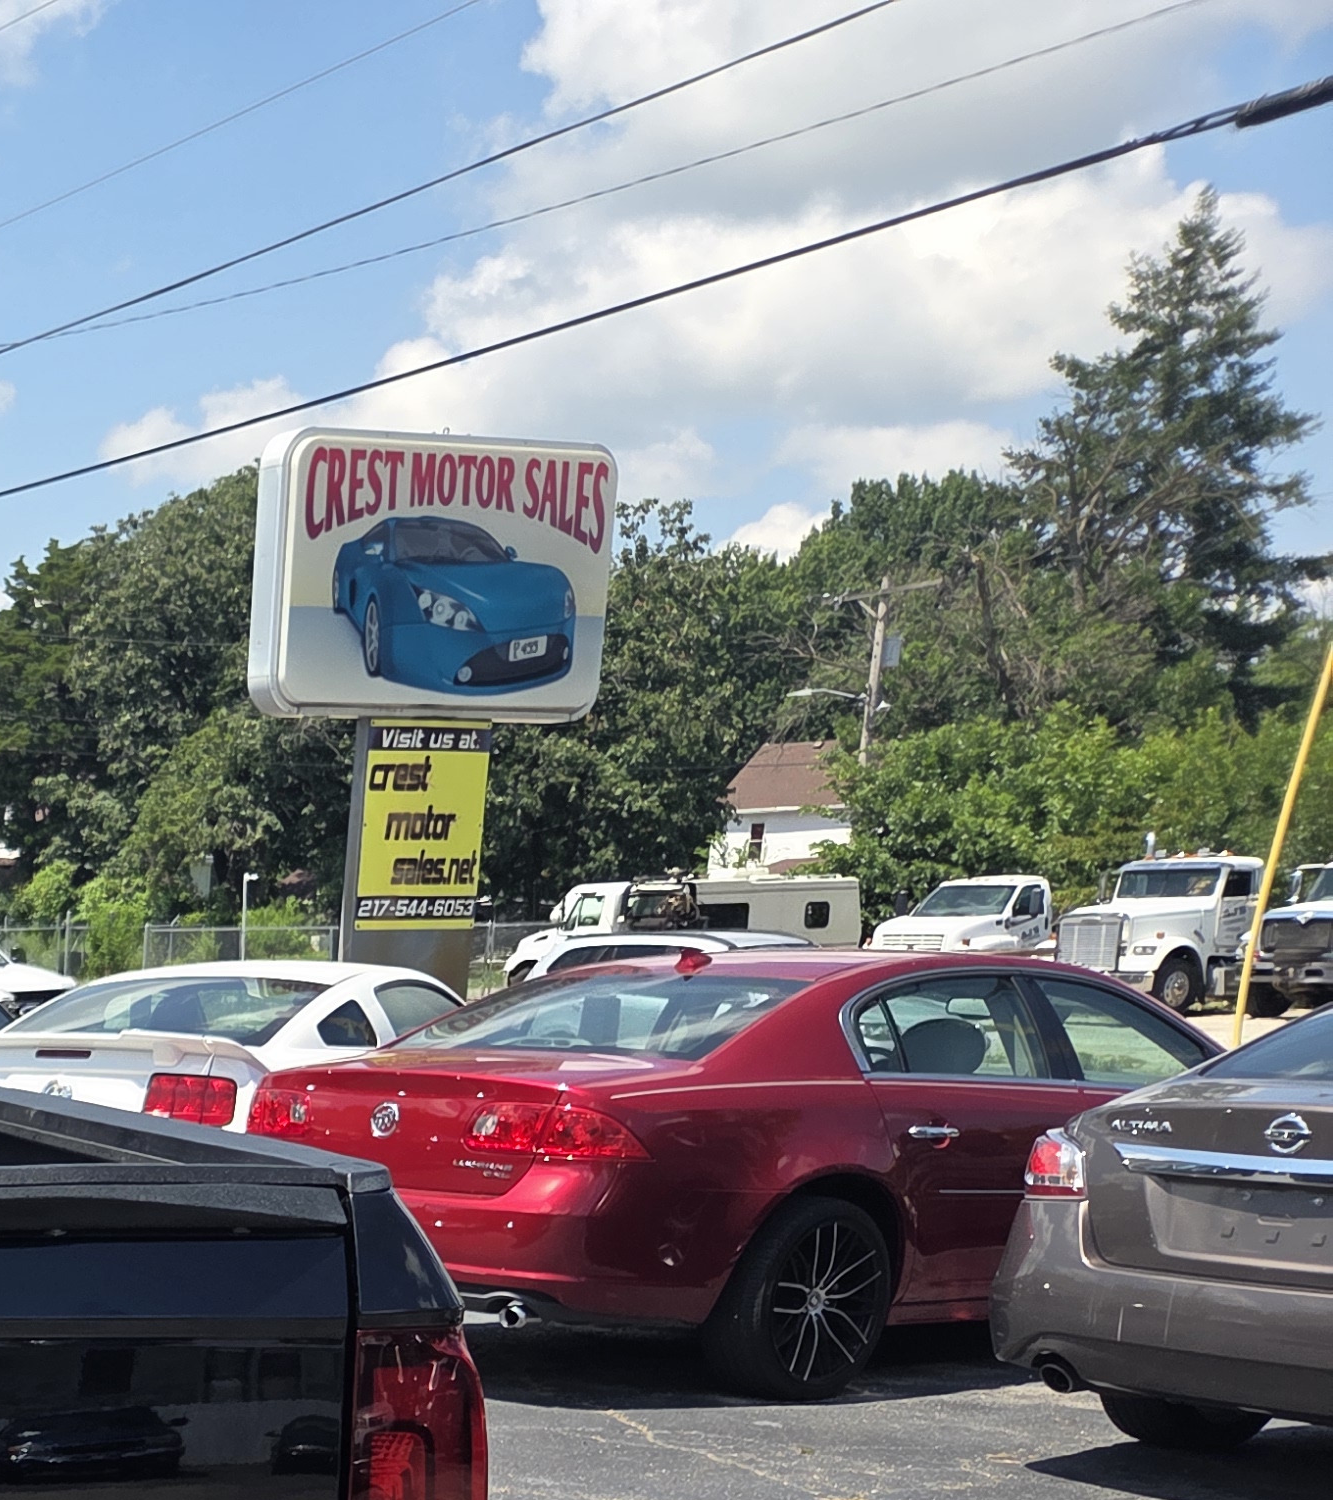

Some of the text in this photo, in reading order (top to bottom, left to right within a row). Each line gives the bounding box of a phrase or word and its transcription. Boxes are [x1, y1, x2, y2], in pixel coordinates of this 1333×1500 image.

[305, 446, 609, 554] CREST MOTOR SALES
[382, 728, 425, 748] Visit
[429, 732, 455, 749] us
[369, 755, 432, 792] crest
[384, 804, 457, 841] motor
[390, 849, 477, 885] sales.net
[357, 899, 475, 918] 217-544-6053
[1112, 1119, 1172, 1132] ALTIMA
